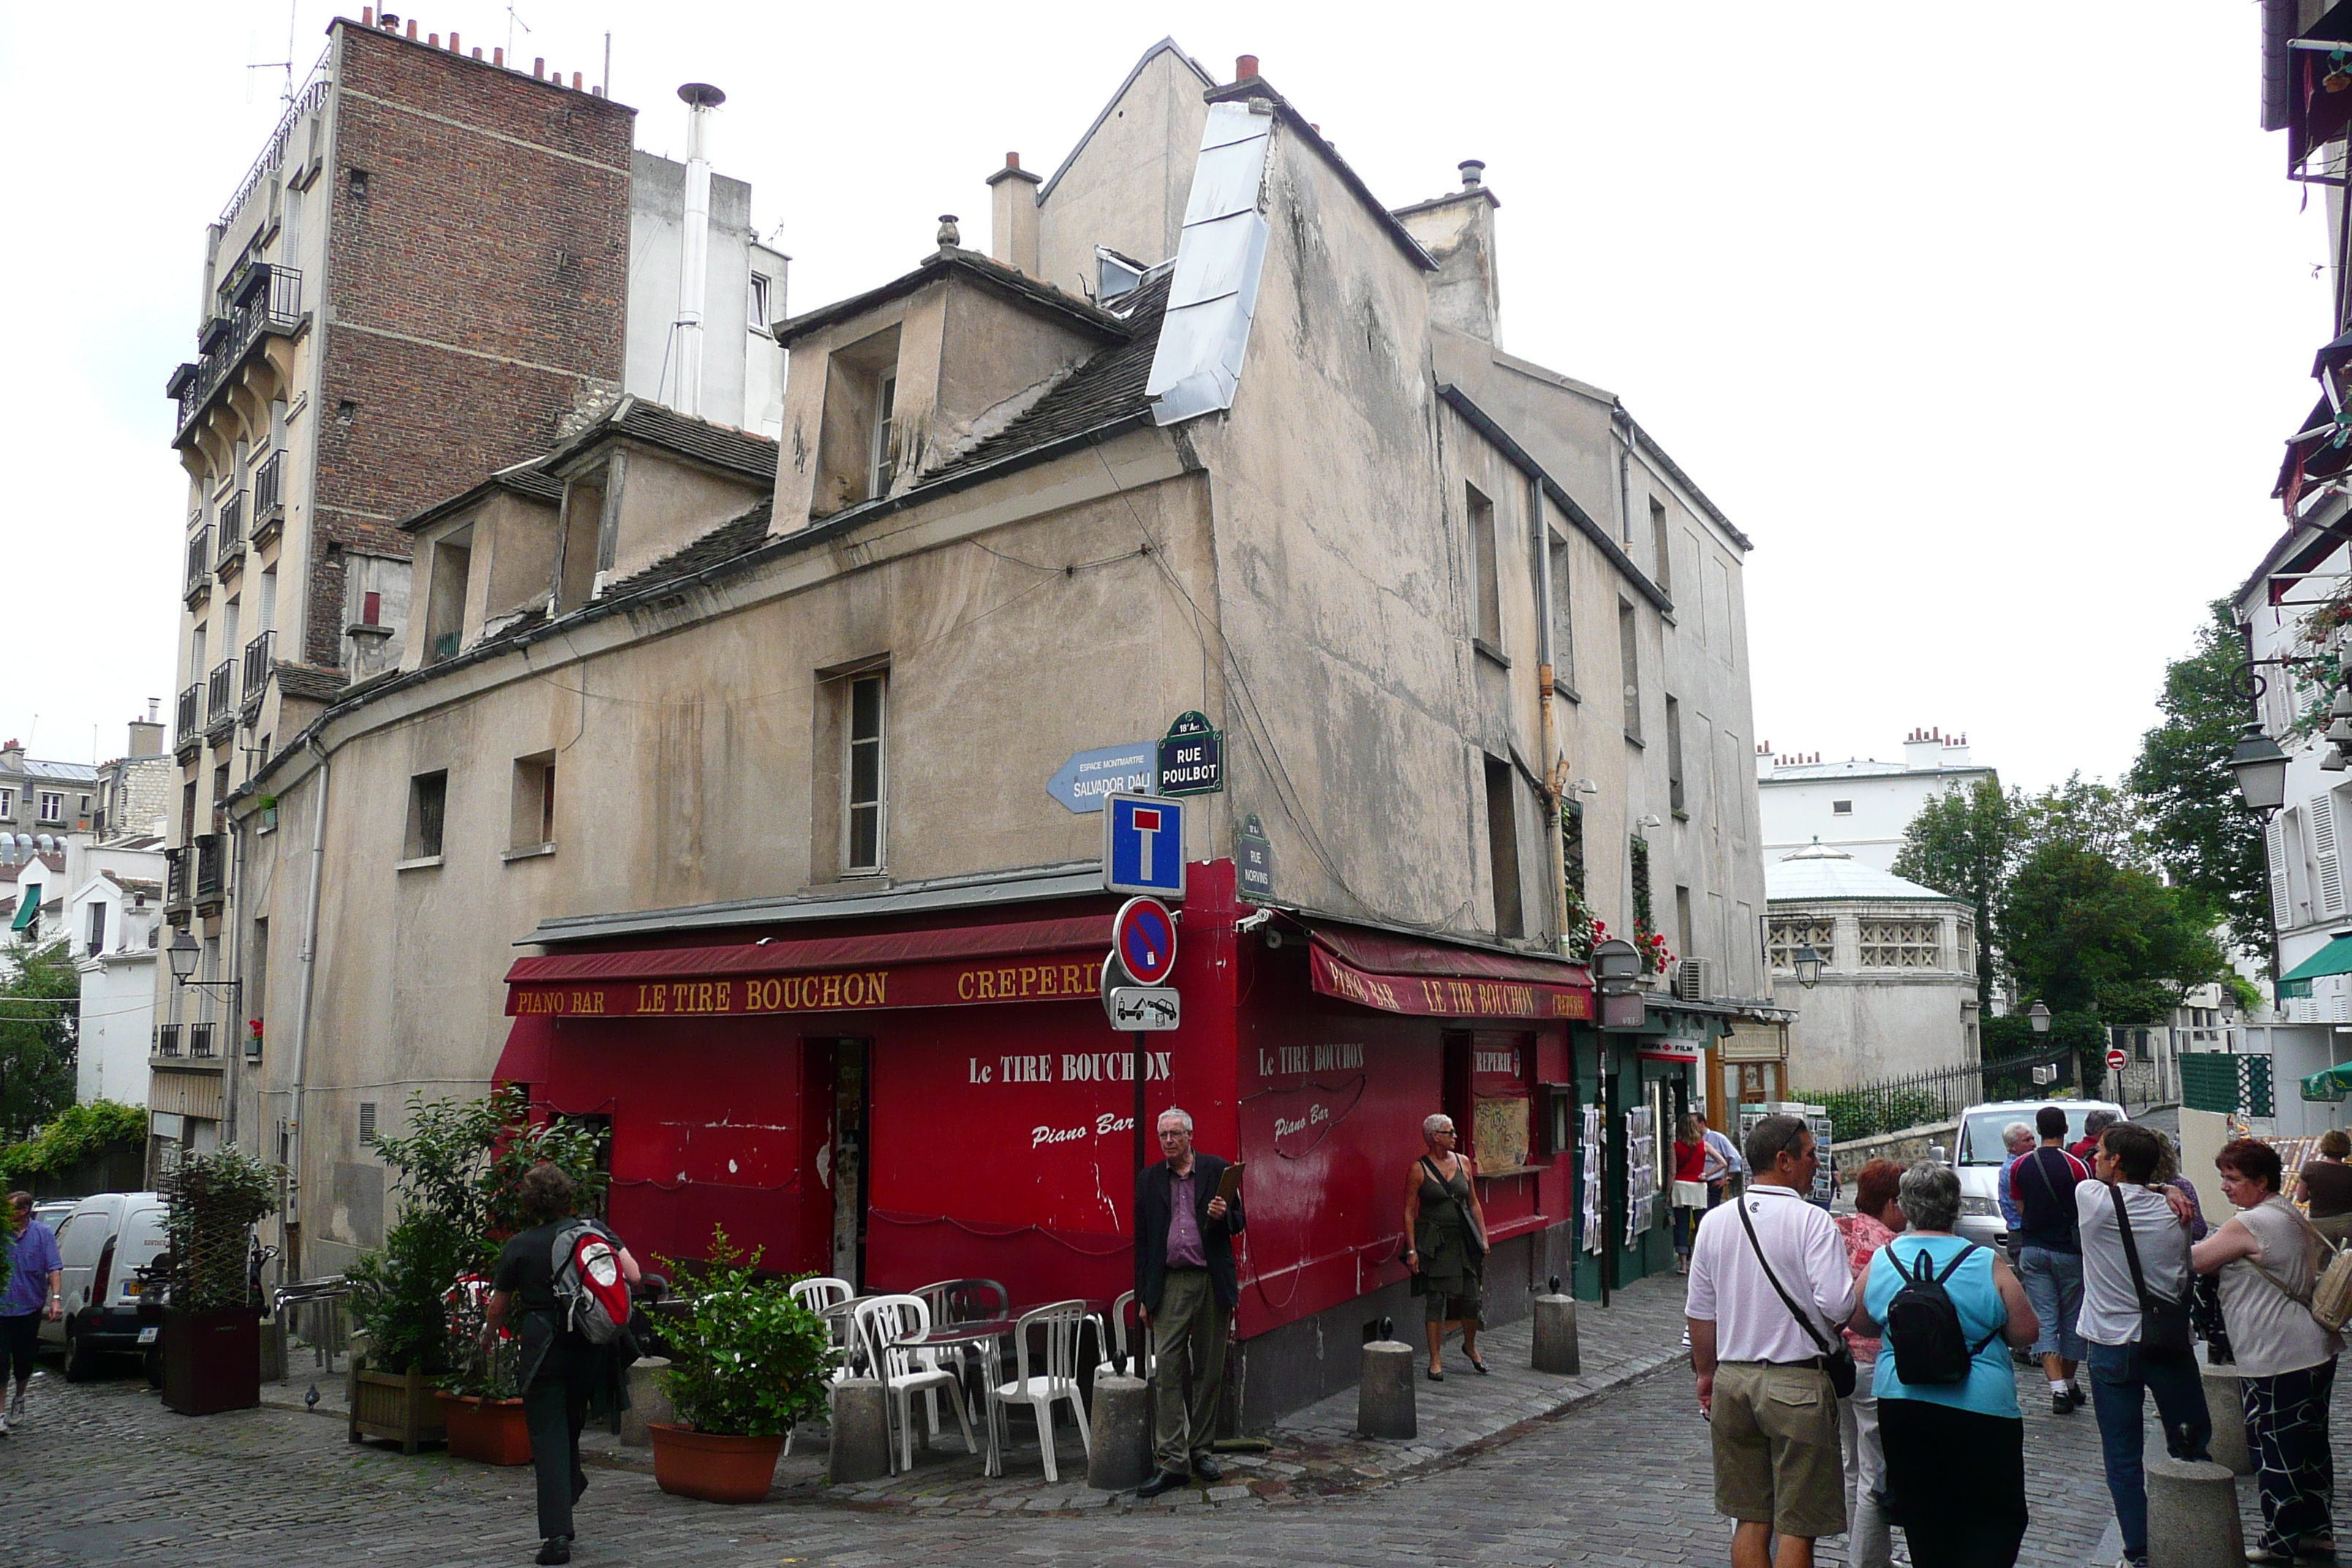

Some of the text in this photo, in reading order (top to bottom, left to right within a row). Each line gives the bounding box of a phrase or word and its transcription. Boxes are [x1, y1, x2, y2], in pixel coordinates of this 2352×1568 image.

[1079, 755, 1145, 772] ESPACE MONTMARTRE
[1177, 747, 1202, 764] RUE
[1074, 772, 1150, 797] SALVADOR DALI
[1163, 764, 1216, 785] POULBOT
[1250, 850, 1262, 864] RUE
[1245, 868, 1268, 885] NORVINS
[516, 962, 1103, 1013] PIANO BAR LE TIRE BOUCHON CREPERI
[1328, 961, 1586, 1017] PIANO BAR LE TIR BOUCHON CREPERIE
[969, 1052, 1172, 1085] Le TIRE BOUCHON
[1259, 1043, 1365, 1077] Le TIRE BOUCHON
[1031, 1112, 1135, 1149] Piano Bar
[1274, 1104, 1330, 1142] Piano Bar
